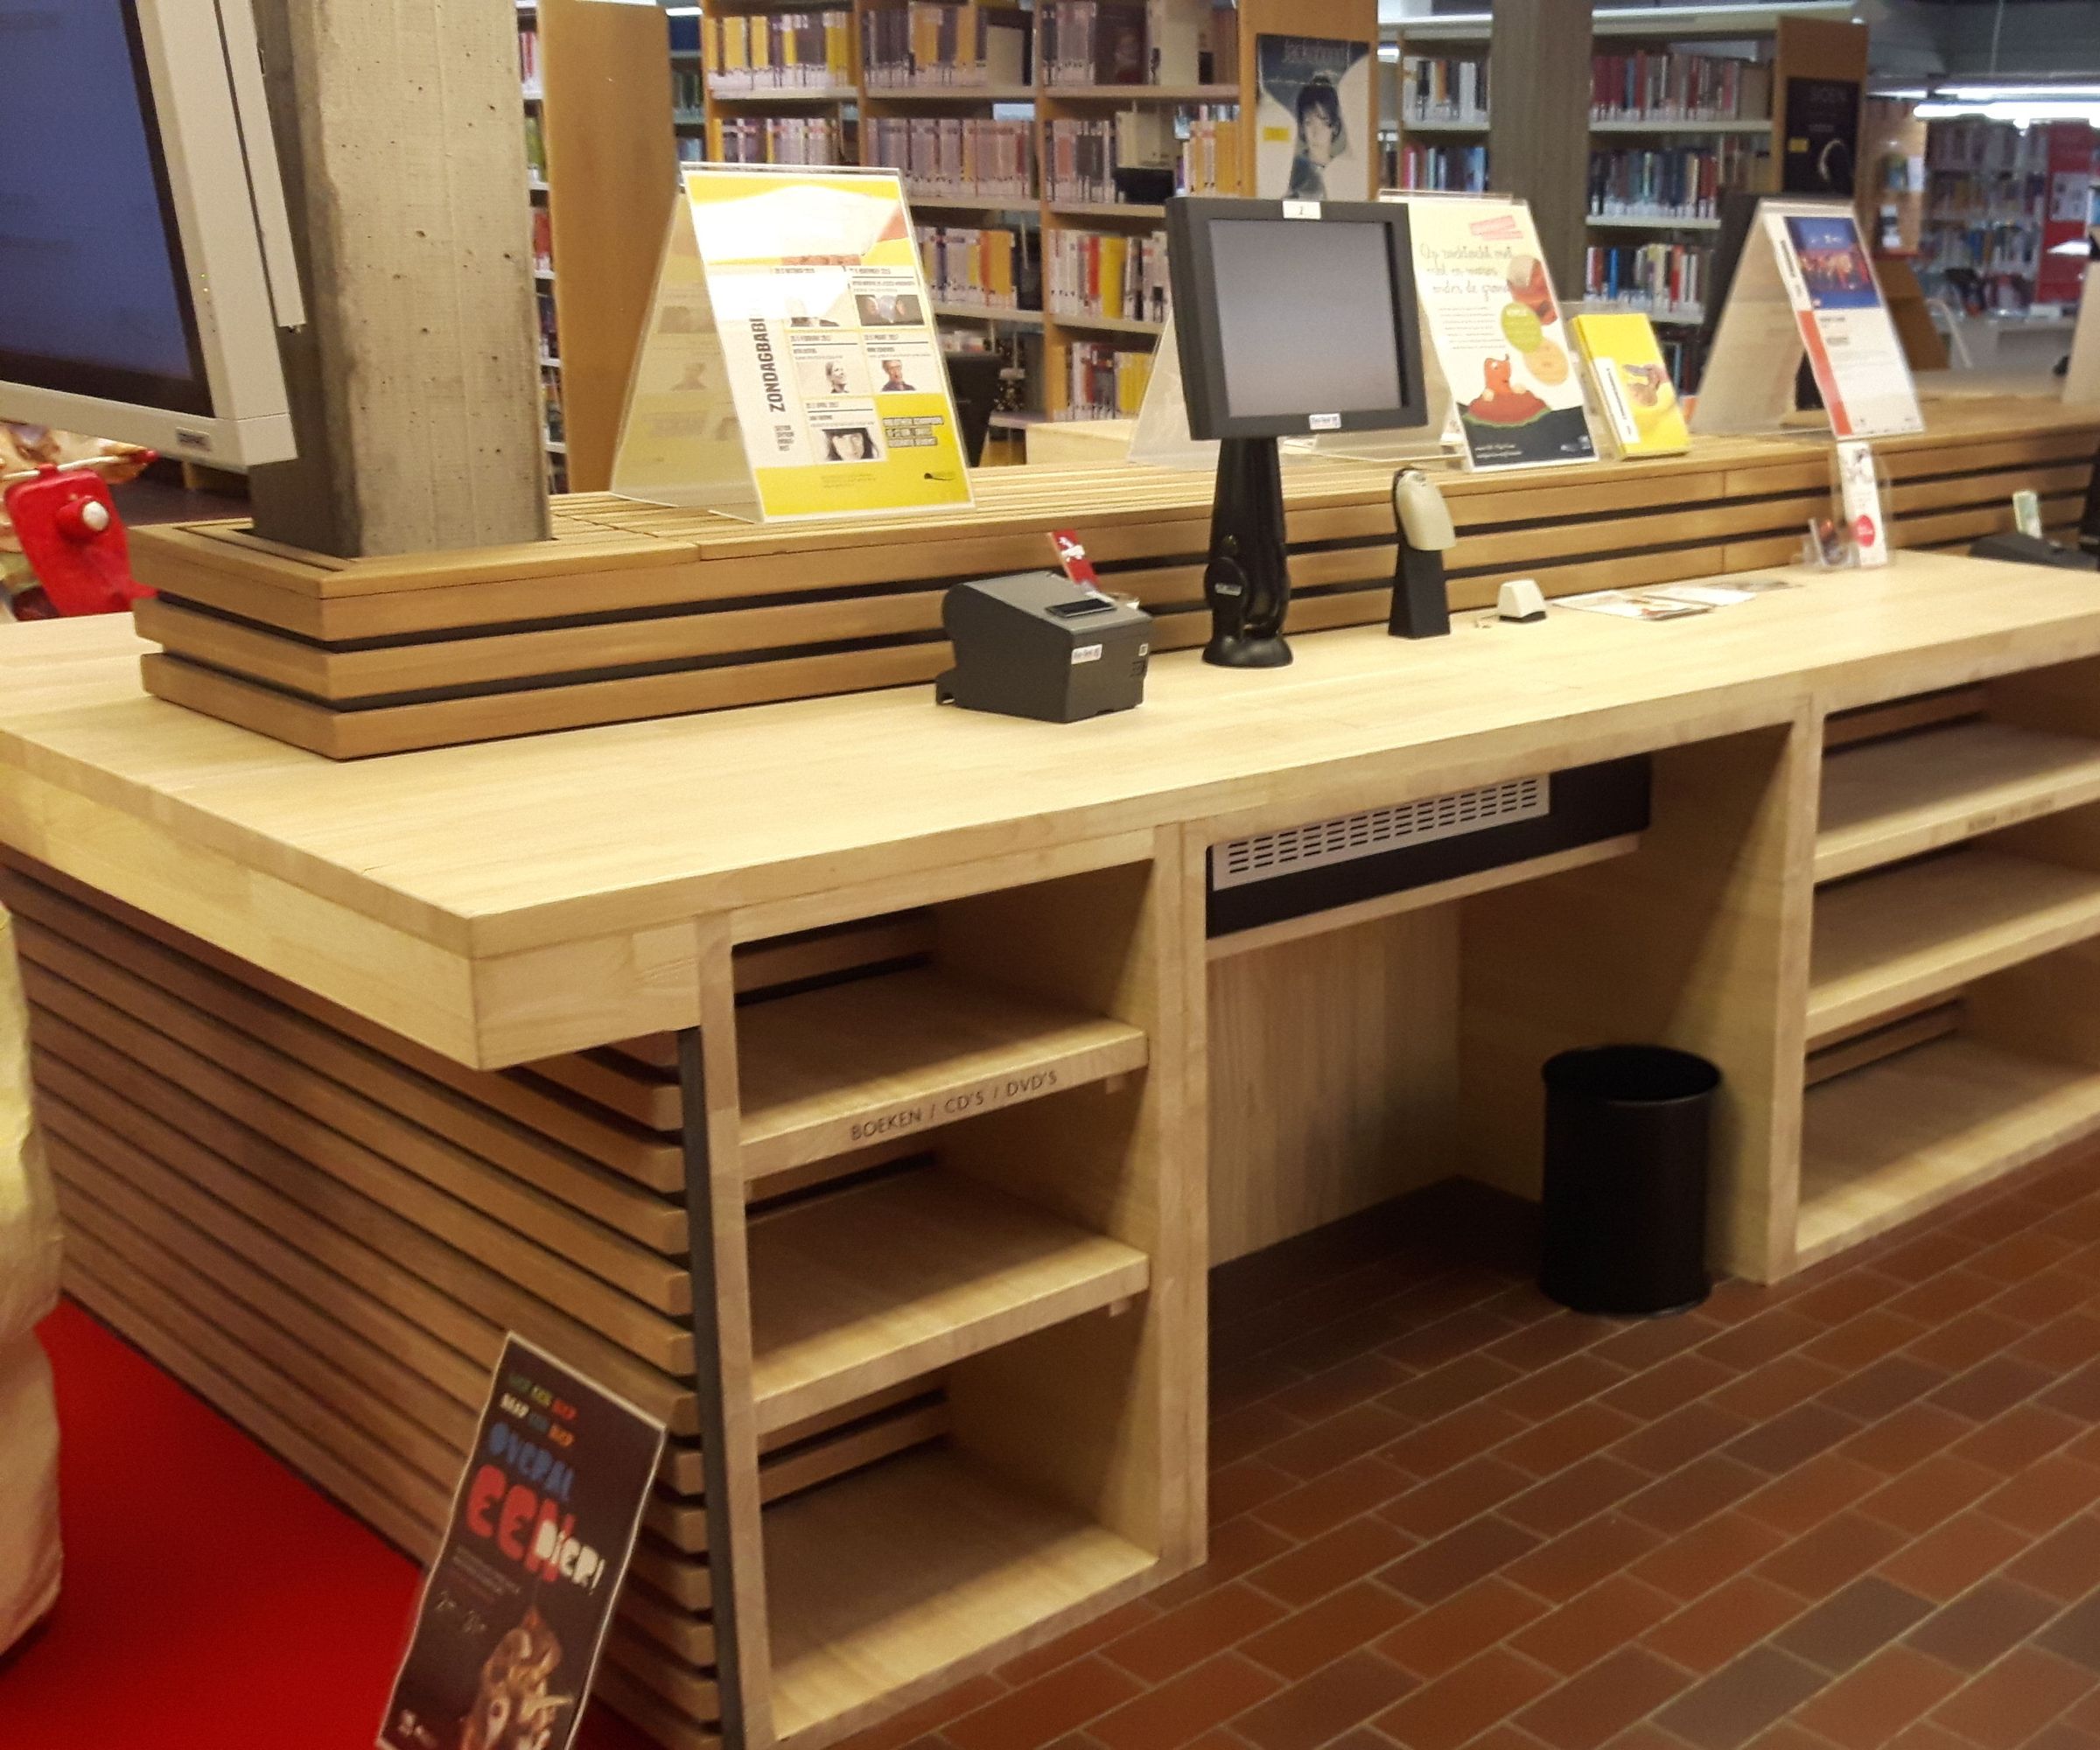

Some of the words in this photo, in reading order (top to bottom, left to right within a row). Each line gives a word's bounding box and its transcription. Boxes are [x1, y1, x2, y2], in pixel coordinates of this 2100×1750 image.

[850, 1108, 922, 1141] BOEKEN
[930, 1104, 935, 1119] /
[943, 1091, 984, 1114] CD'S
[1006, 1070, 1058, 1097] DVD'S
